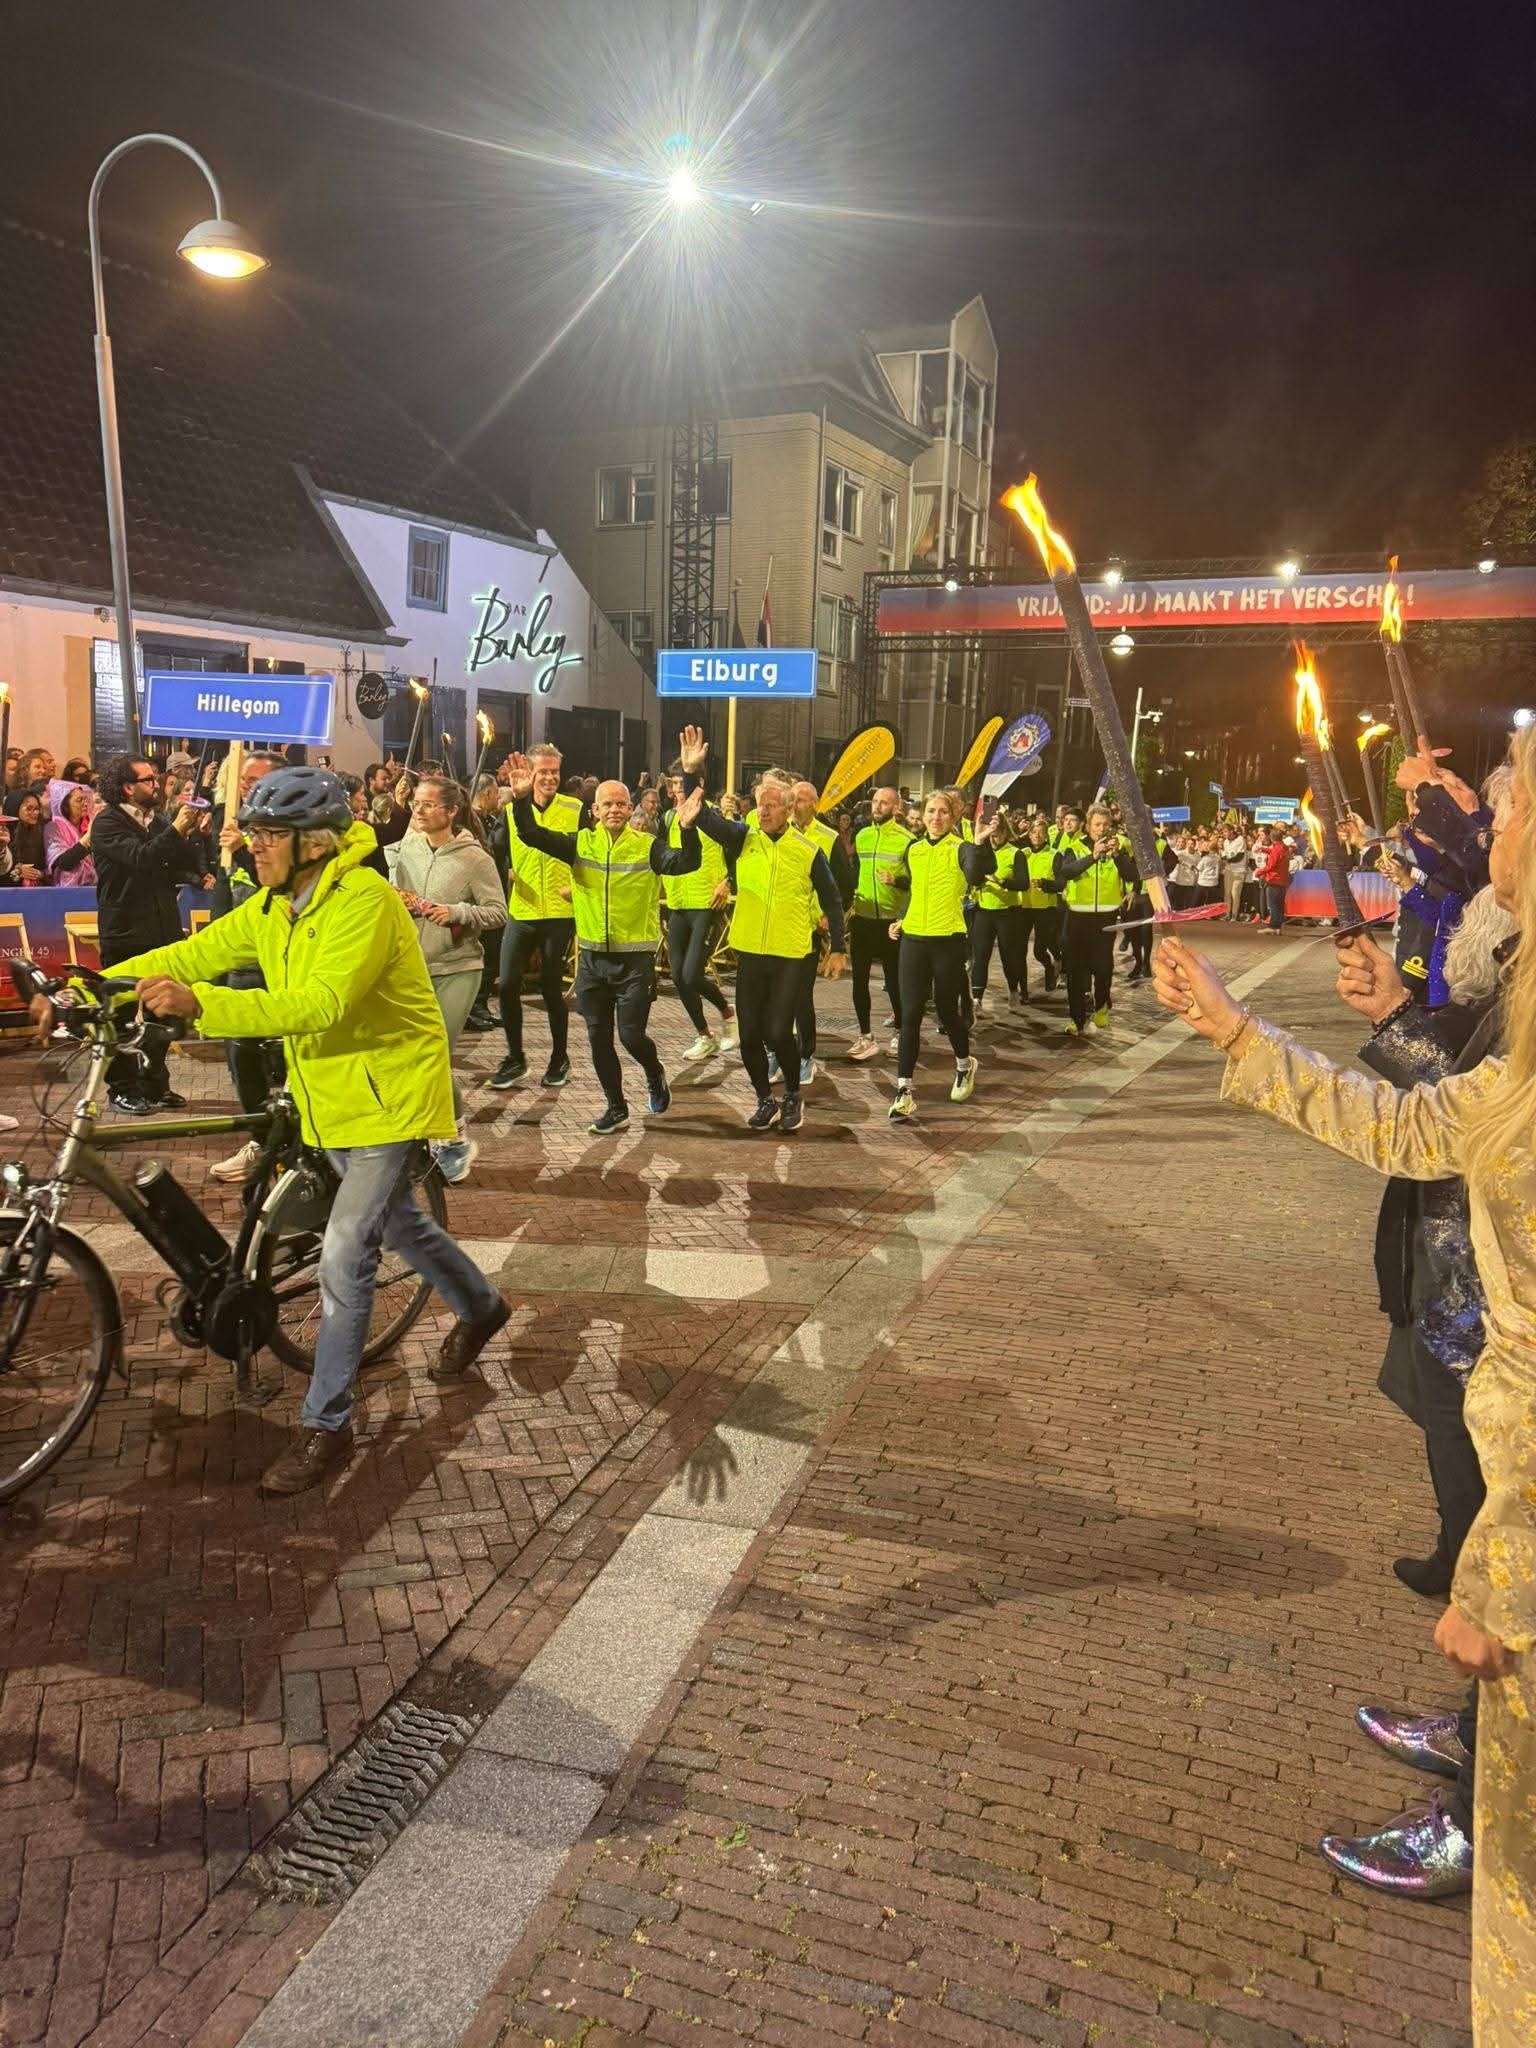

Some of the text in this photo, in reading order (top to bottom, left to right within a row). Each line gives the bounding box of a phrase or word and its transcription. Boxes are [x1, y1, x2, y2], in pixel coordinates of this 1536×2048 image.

[507, 602, 527, 616] BAR
[1016, 583, 1415, 617] VRIJID: JIJ MAAKT HET VERSCH!
[470, 587, 584, 693] Barley
[690, 658, 779, 689] Elburg
[196, 693, 280, 719] Hillegom
[37, 946, 50, 955] 45
